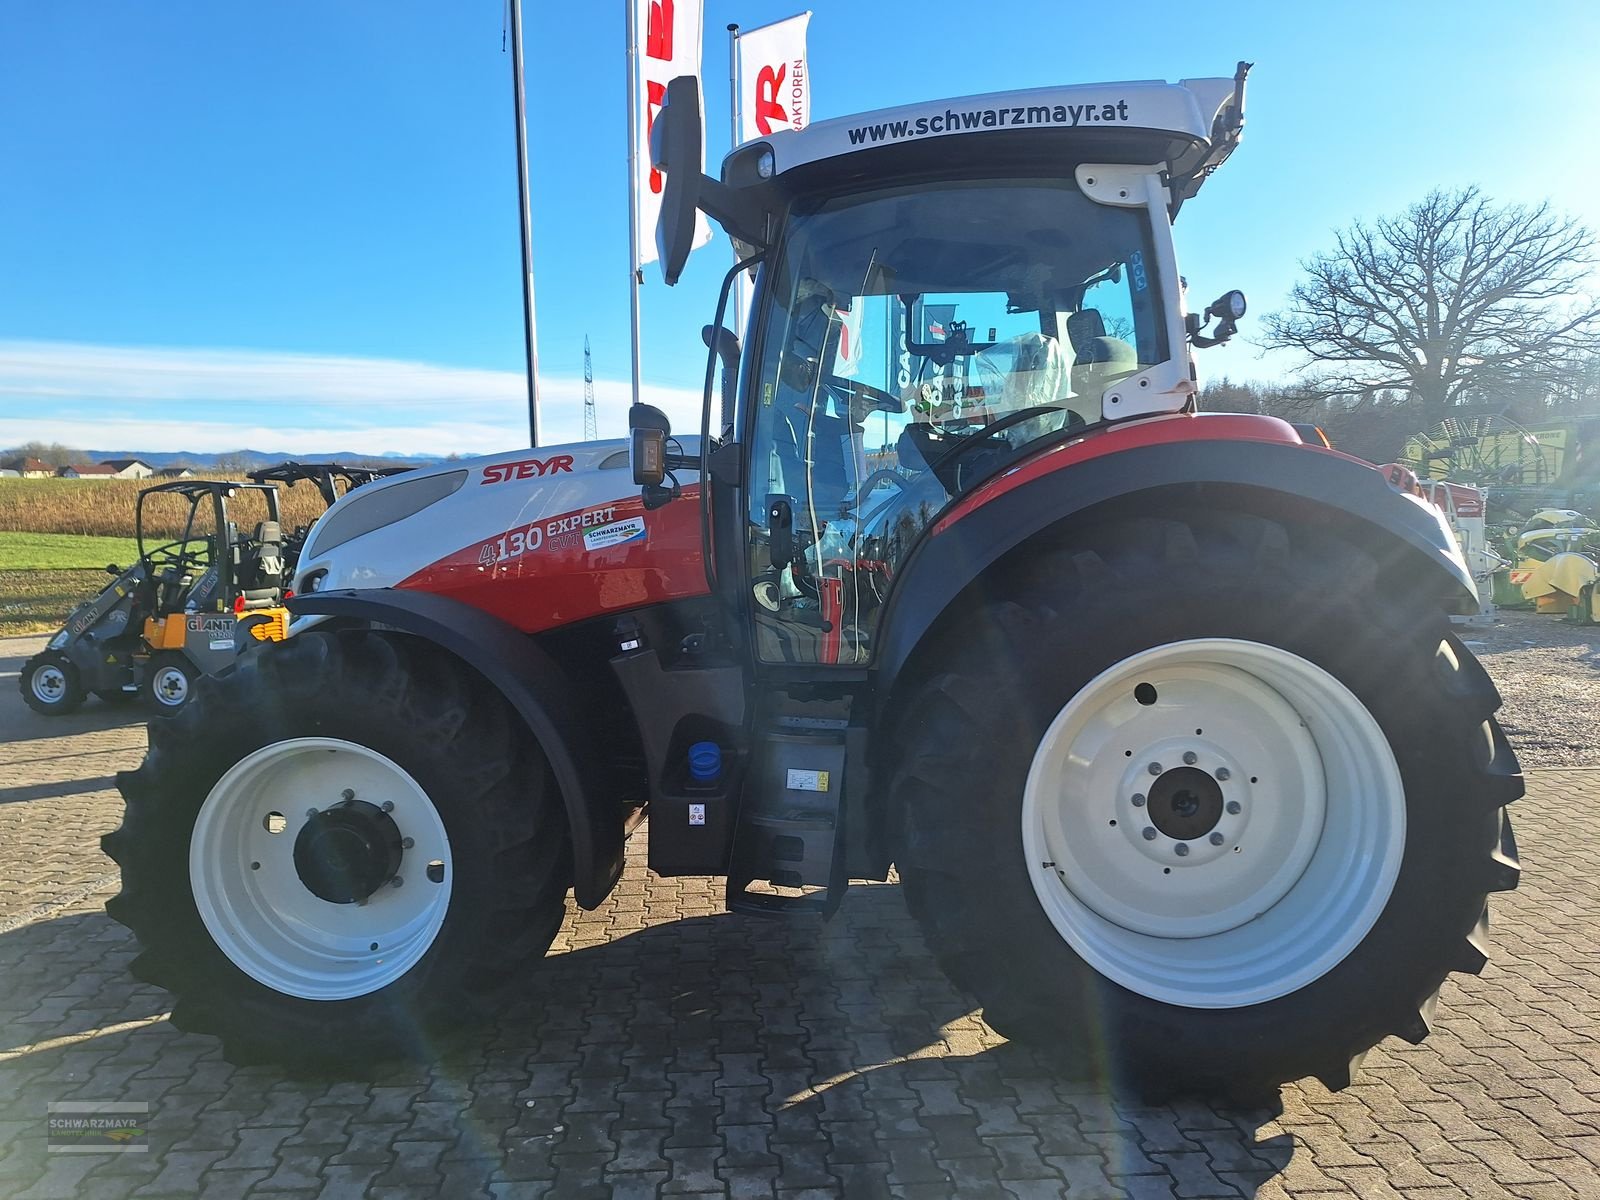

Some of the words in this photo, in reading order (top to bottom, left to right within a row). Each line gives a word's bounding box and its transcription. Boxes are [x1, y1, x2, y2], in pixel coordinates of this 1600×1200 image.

[755, 62, 787, 136] R
[848, 100, 1128, 145] www.schwarzmayr.at
[480, 455, 574, 485] STEYR
[479, 526, 543, 567] 4130
[547, 507, 616, 537] EXPERT
[549, 531, 581, 551] CVT
[588, 523, 636, 539] SCHWARZMAYR
